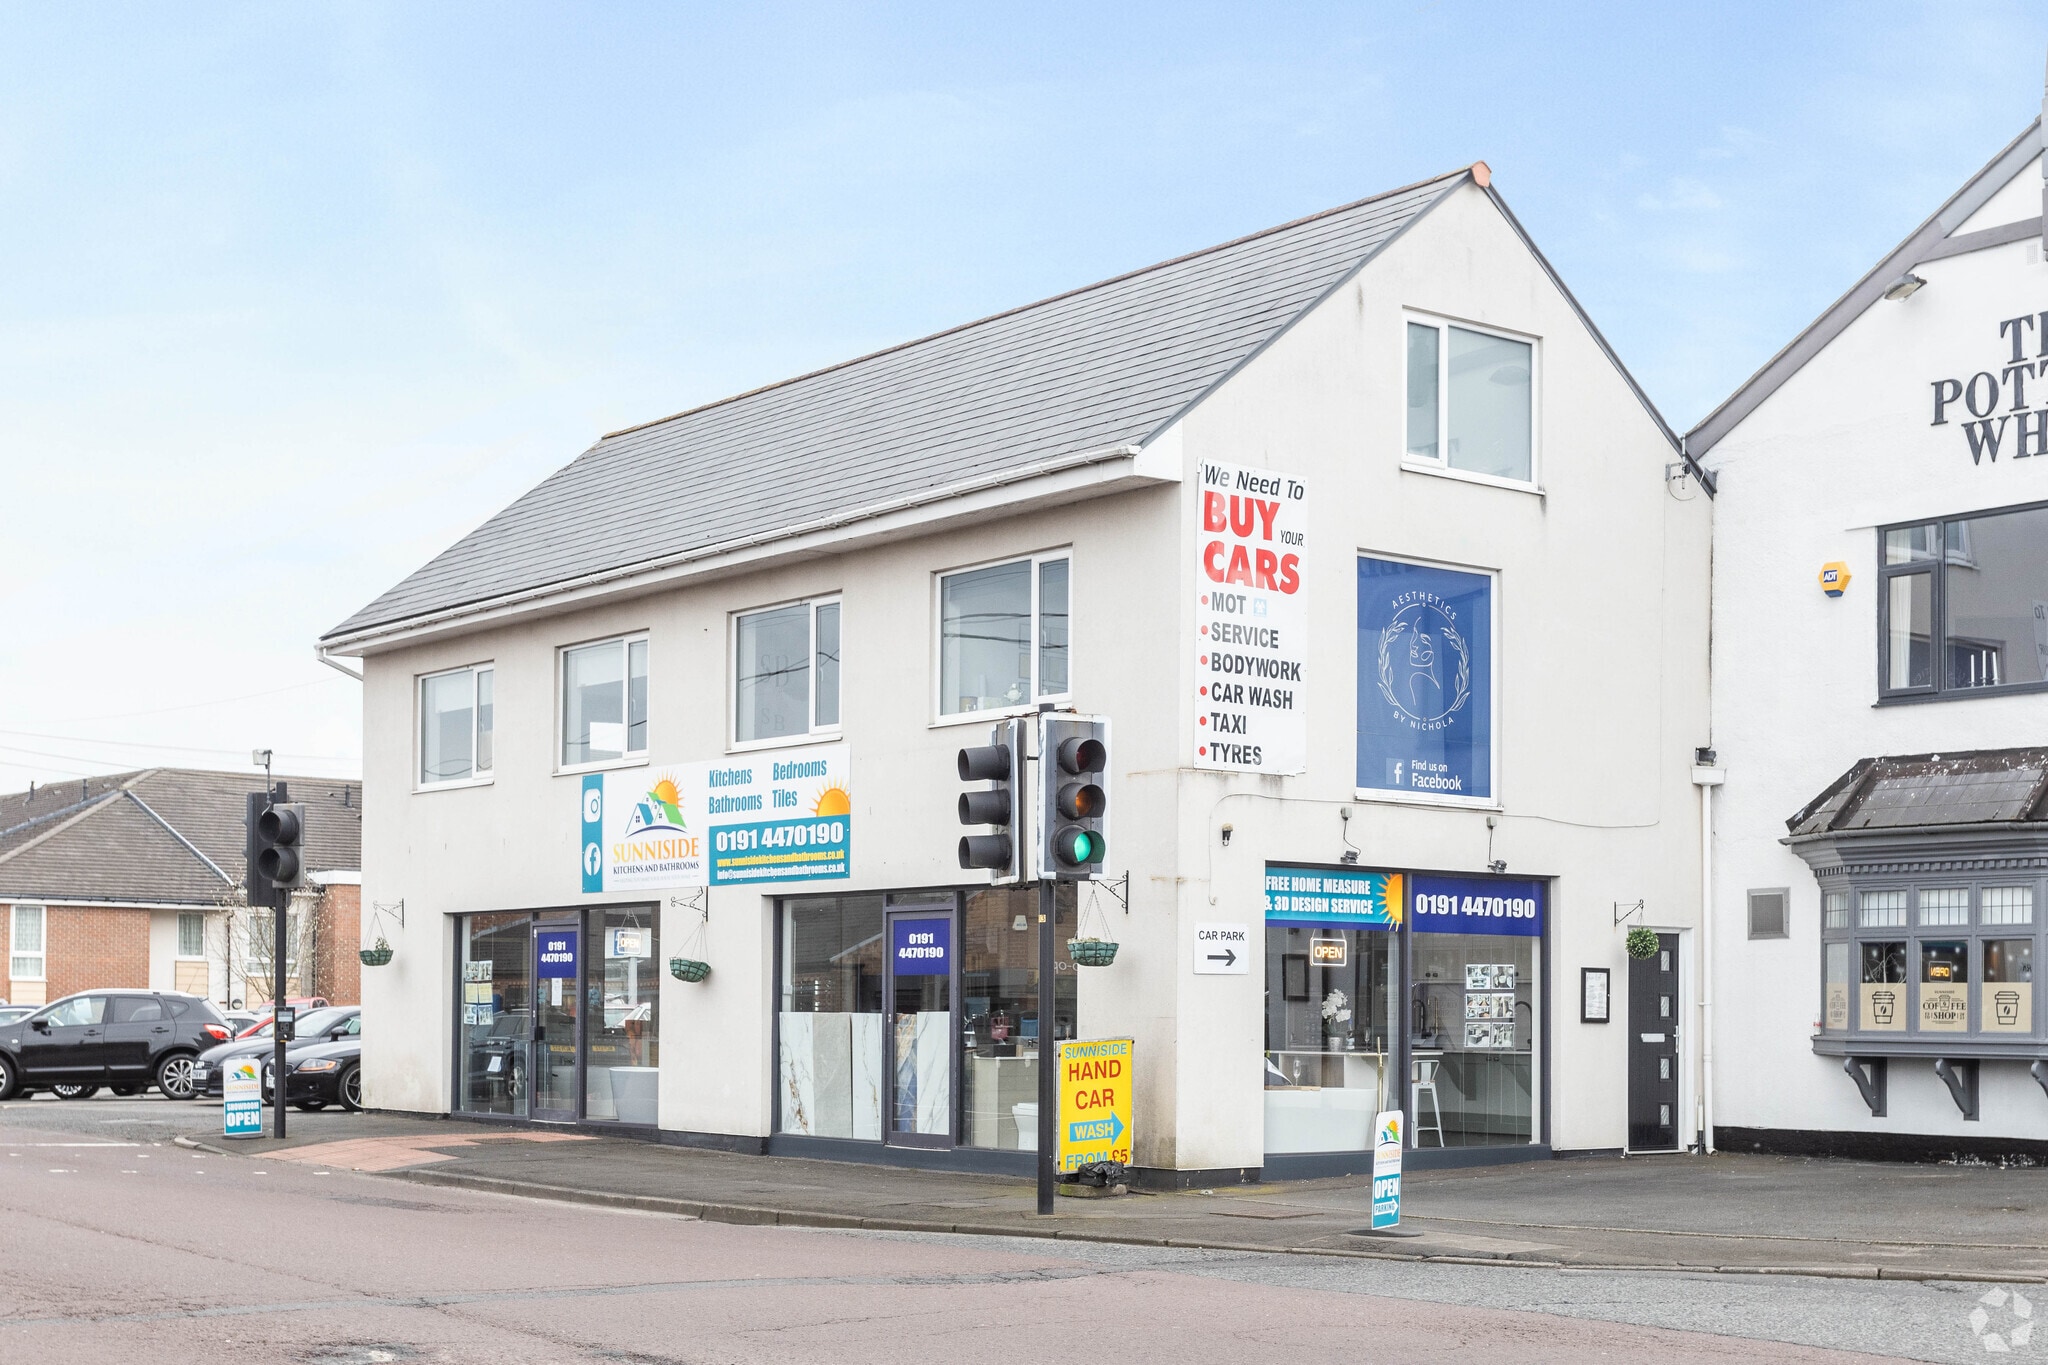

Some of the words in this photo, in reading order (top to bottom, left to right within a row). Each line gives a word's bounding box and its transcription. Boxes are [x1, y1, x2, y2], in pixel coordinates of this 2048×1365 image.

[1930, 359, 2048, 426] POT
[1205, 464, 1230, 487] We
[1236, 470, 1281, 497] Need
[1287, 480, 1304, 500] To
[1203, 490, 1281, 541] BUY
[1280, 530, 1304, 546] YOUR
[1203, 540, 1300, 595] CARS
[1824, 570, 1838, 582] ADT
[1211, 591, 1246, 614] MOT
[1392, 591, 1457, 620] AESTHETICS
[1211, 621, 1279, 649] SERVICE
[1211, 652, 1302, 682] BODYWORK
[1211, 682, 1244, 705] CAR
[1248, 686, 1293, 710] WASH
[1210, 712, 1247, 734] TAXI
[1393, 710, 1406, 723] BY
[1410, 716, 1454, 731] NICHOLA
[1210, 742, 1262, 765] TYRES
[709, 768, 752, 788] Kitchens
[773, 760, 827, 781] Bedrooms
[1411, 760, 1427, 771] Find
[1429, 763, 1437, 772] us
[1438, 764, 1448, 772] on
[1412, 772, 1462, 791] Facebook
[709, 794, 762, 814] Bathrooms
[772, 789, 798, 808] Tiles
[716, 829, 757, 852] 0191
[761, 821, 844, 848] 4470190
[613, 837, 699, 864] SUNNISIDE
[613, 865, 644, 875] KITCHENS
[645, 864, 658, 872] AND
[659, 861, 699, 872] BATHROOMS
[1265, 875, 1290, 891] FREE
[1291, 877, 1321, 893] HOME
[1323, 878, 1371, 895] MEASURE
[1265, 895, 1273, 911] &
[1274, 896, 1289, 911] 3D
[1291, 896, 1329, 913] DESIGN
[1331, 898, 1373, 914] SERVICE
[1416, 893, 1458, 915] 0191
[1461, 896, 1536, 918] 4470190
[548, 941, 566, 951] 0191
[621, 937, 640, 949] OPEN
[909, 932, 934, 945] 0191
[1198, 930, 1218, 940] CAR
[1220, 931, 1245, 941] PARK
[541, 952, 573, 963] 4470190
[898, 946, 944, 959] 4470190
[1314, 946, 1343, 959] OPEN
[1933, 1011, 1956, 1020] SHOP
[1065, 1043, 1128, 1059] SUNNISIDE
[1068, 1059, 1121, 1082] HAND
[1075, 1088, 1115, 1110] CAR
[226, 1111, 260, 1127] OPEN
[1074, 1122, 1114, 1140] WASH
[1066, 1151, 1107, 1169] FROM
[1112, 1148, 1128, 1163] £5
[1375, 1176, 1399, 1199] OPEN
